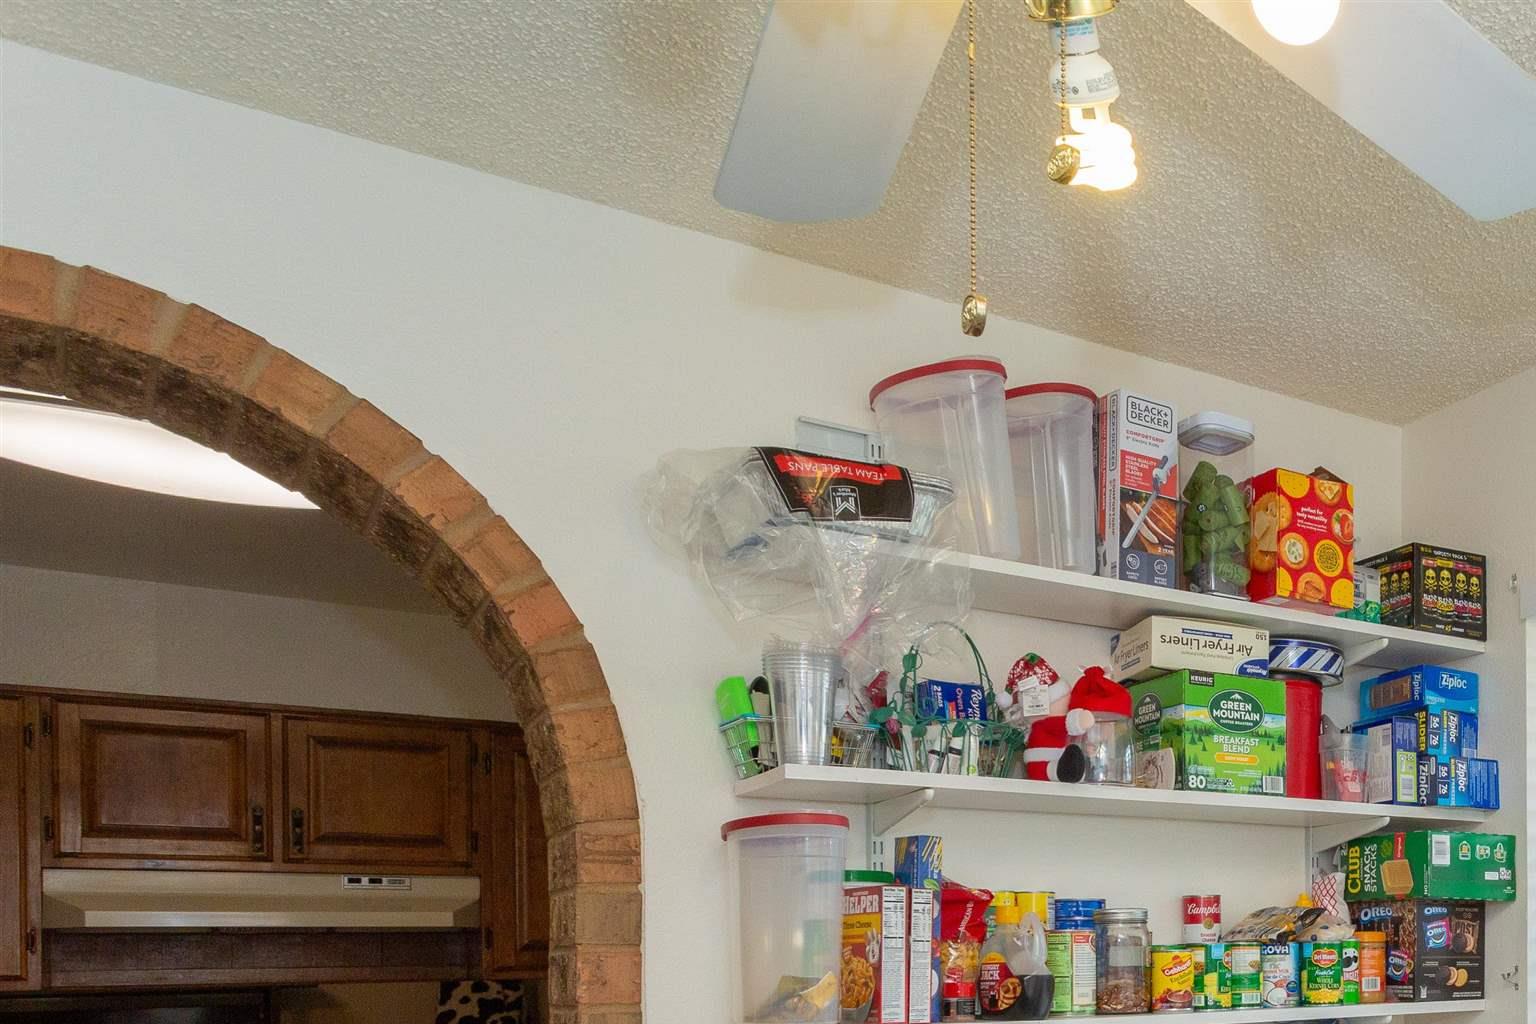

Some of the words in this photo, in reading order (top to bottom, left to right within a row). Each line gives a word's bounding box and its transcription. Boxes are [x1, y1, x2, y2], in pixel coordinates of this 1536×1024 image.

[1130, 401, 1168, 418] BLACK+
[1130, 411, 1168, 428] DECKER
[788, 461, 817, 472] PANS
[826, 464, 854, 475] TABLE
[854, 468, 888, 482] TEAM
[1160, 634, 1199, 650] Liners
[1202, 639, 1234, 654] Fryer
[1237, 644, 1253, 656] Air
[1440, 674, 1467, 689] Ziploc
[1138, 704, 1156, 714] GREEN
[1220, 700, 1252, 712] GREEN
[1212, 710, 1260, 721] MOUNTAIN
[1432, 716, 1439, 728] 56
[1448, 713, 1457, 743] Ziploc
[1418, 711, 1426, 752] SLIDER
[1214, 735, 1259, 746] BREAKFAST
[1432, 734, 1439, 745] 76
[1224, 743, 1250, 754] BLEND
[1441, 766, 1448, 776] 56
[1457, 761, 1466, 792] Ziploc
[1188, 775, 1206, 788] 80
[1419, 762, 1427, 805] Ziploc
[1440, 783, 1448, 795] 76
[1347, 846, 1360, 893] CLUB
[843, 894, 879, 914] HELPER
[1360, 906, 1392, 920] OREO
[1427, 928, 1446, 936] OREO
[980, 970, 1000, 980] JACK
